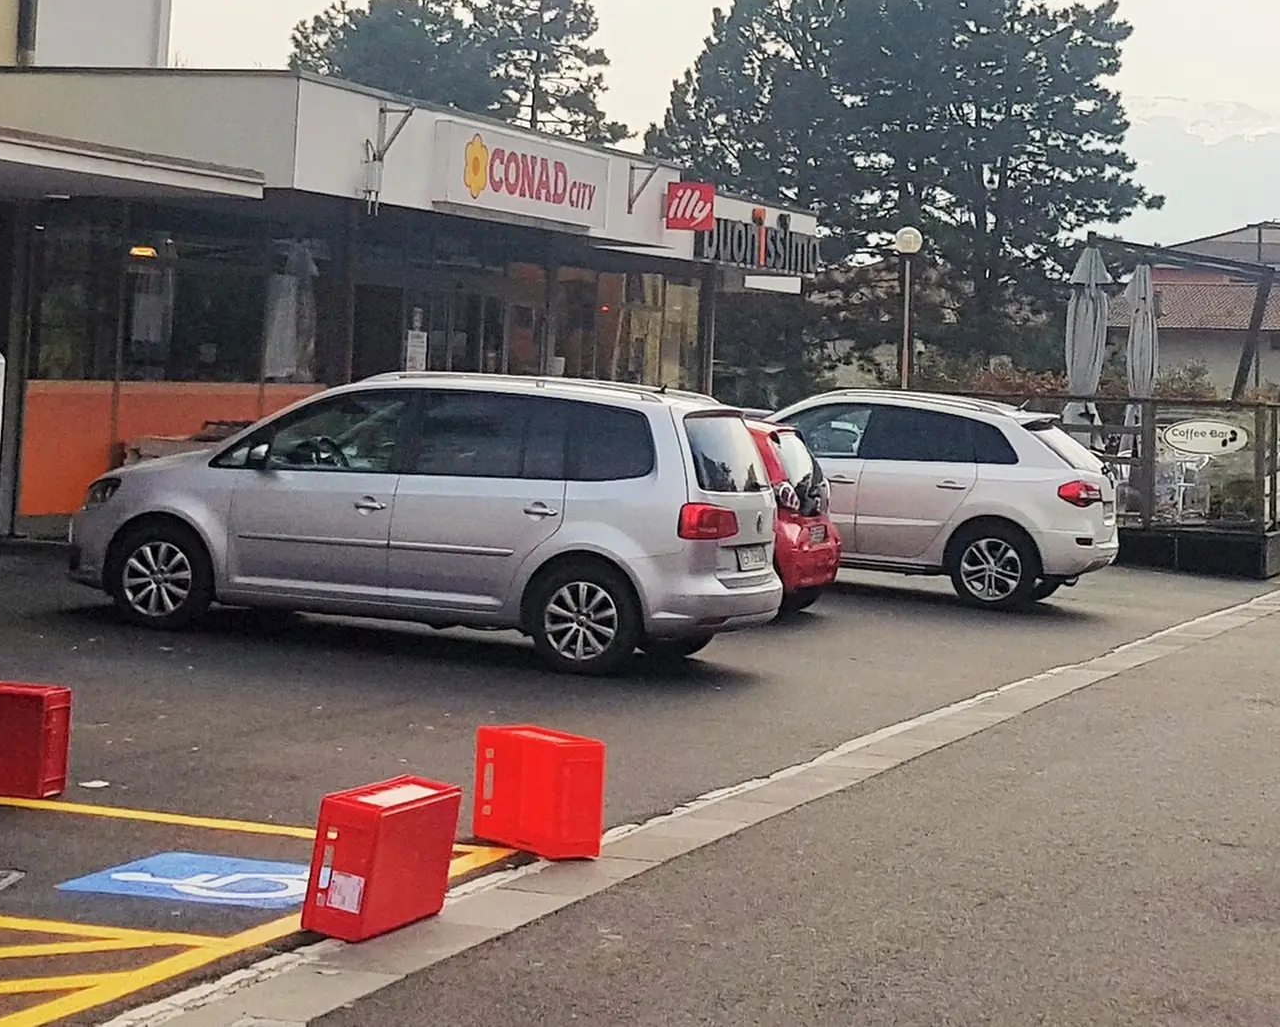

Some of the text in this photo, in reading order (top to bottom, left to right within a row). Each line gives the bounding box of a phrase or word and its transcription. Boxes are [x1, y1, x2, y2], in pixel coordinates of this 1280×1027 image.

[487, 148, 596, 211] CONAD CITY
[668, 187, 711, 226] illy
[1171, 428, 1228, 441] Coffee Bar
